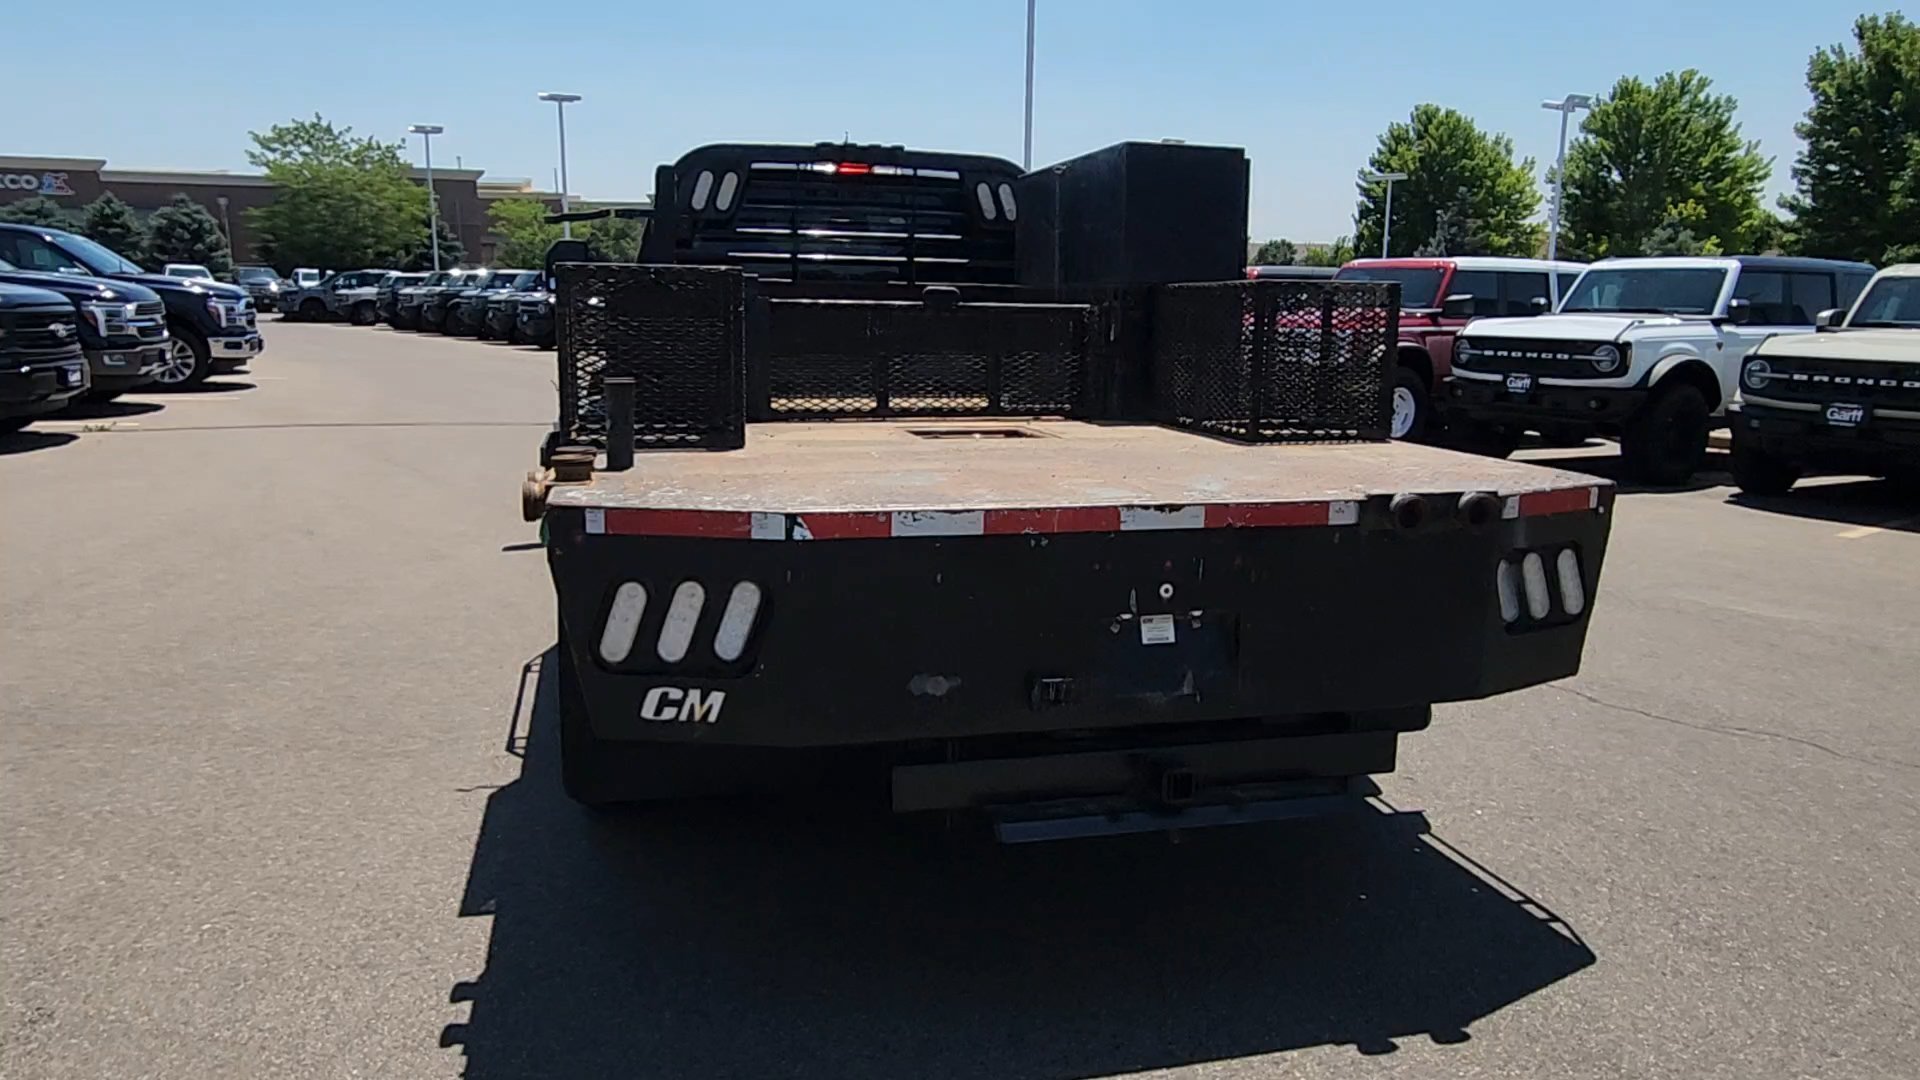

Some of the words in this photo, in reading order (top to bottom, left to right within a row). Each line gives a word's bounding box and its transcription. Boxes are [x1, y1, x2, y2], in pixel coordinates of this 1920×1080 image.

[0, 174, 39, 190] CO
[1483, 349, 1570, 360] BRONCO
[1793, 373, 1920, 388] BRONCO
[1826, 407, 1864, 422] Garff
[640, 686, 727, 723] CM
